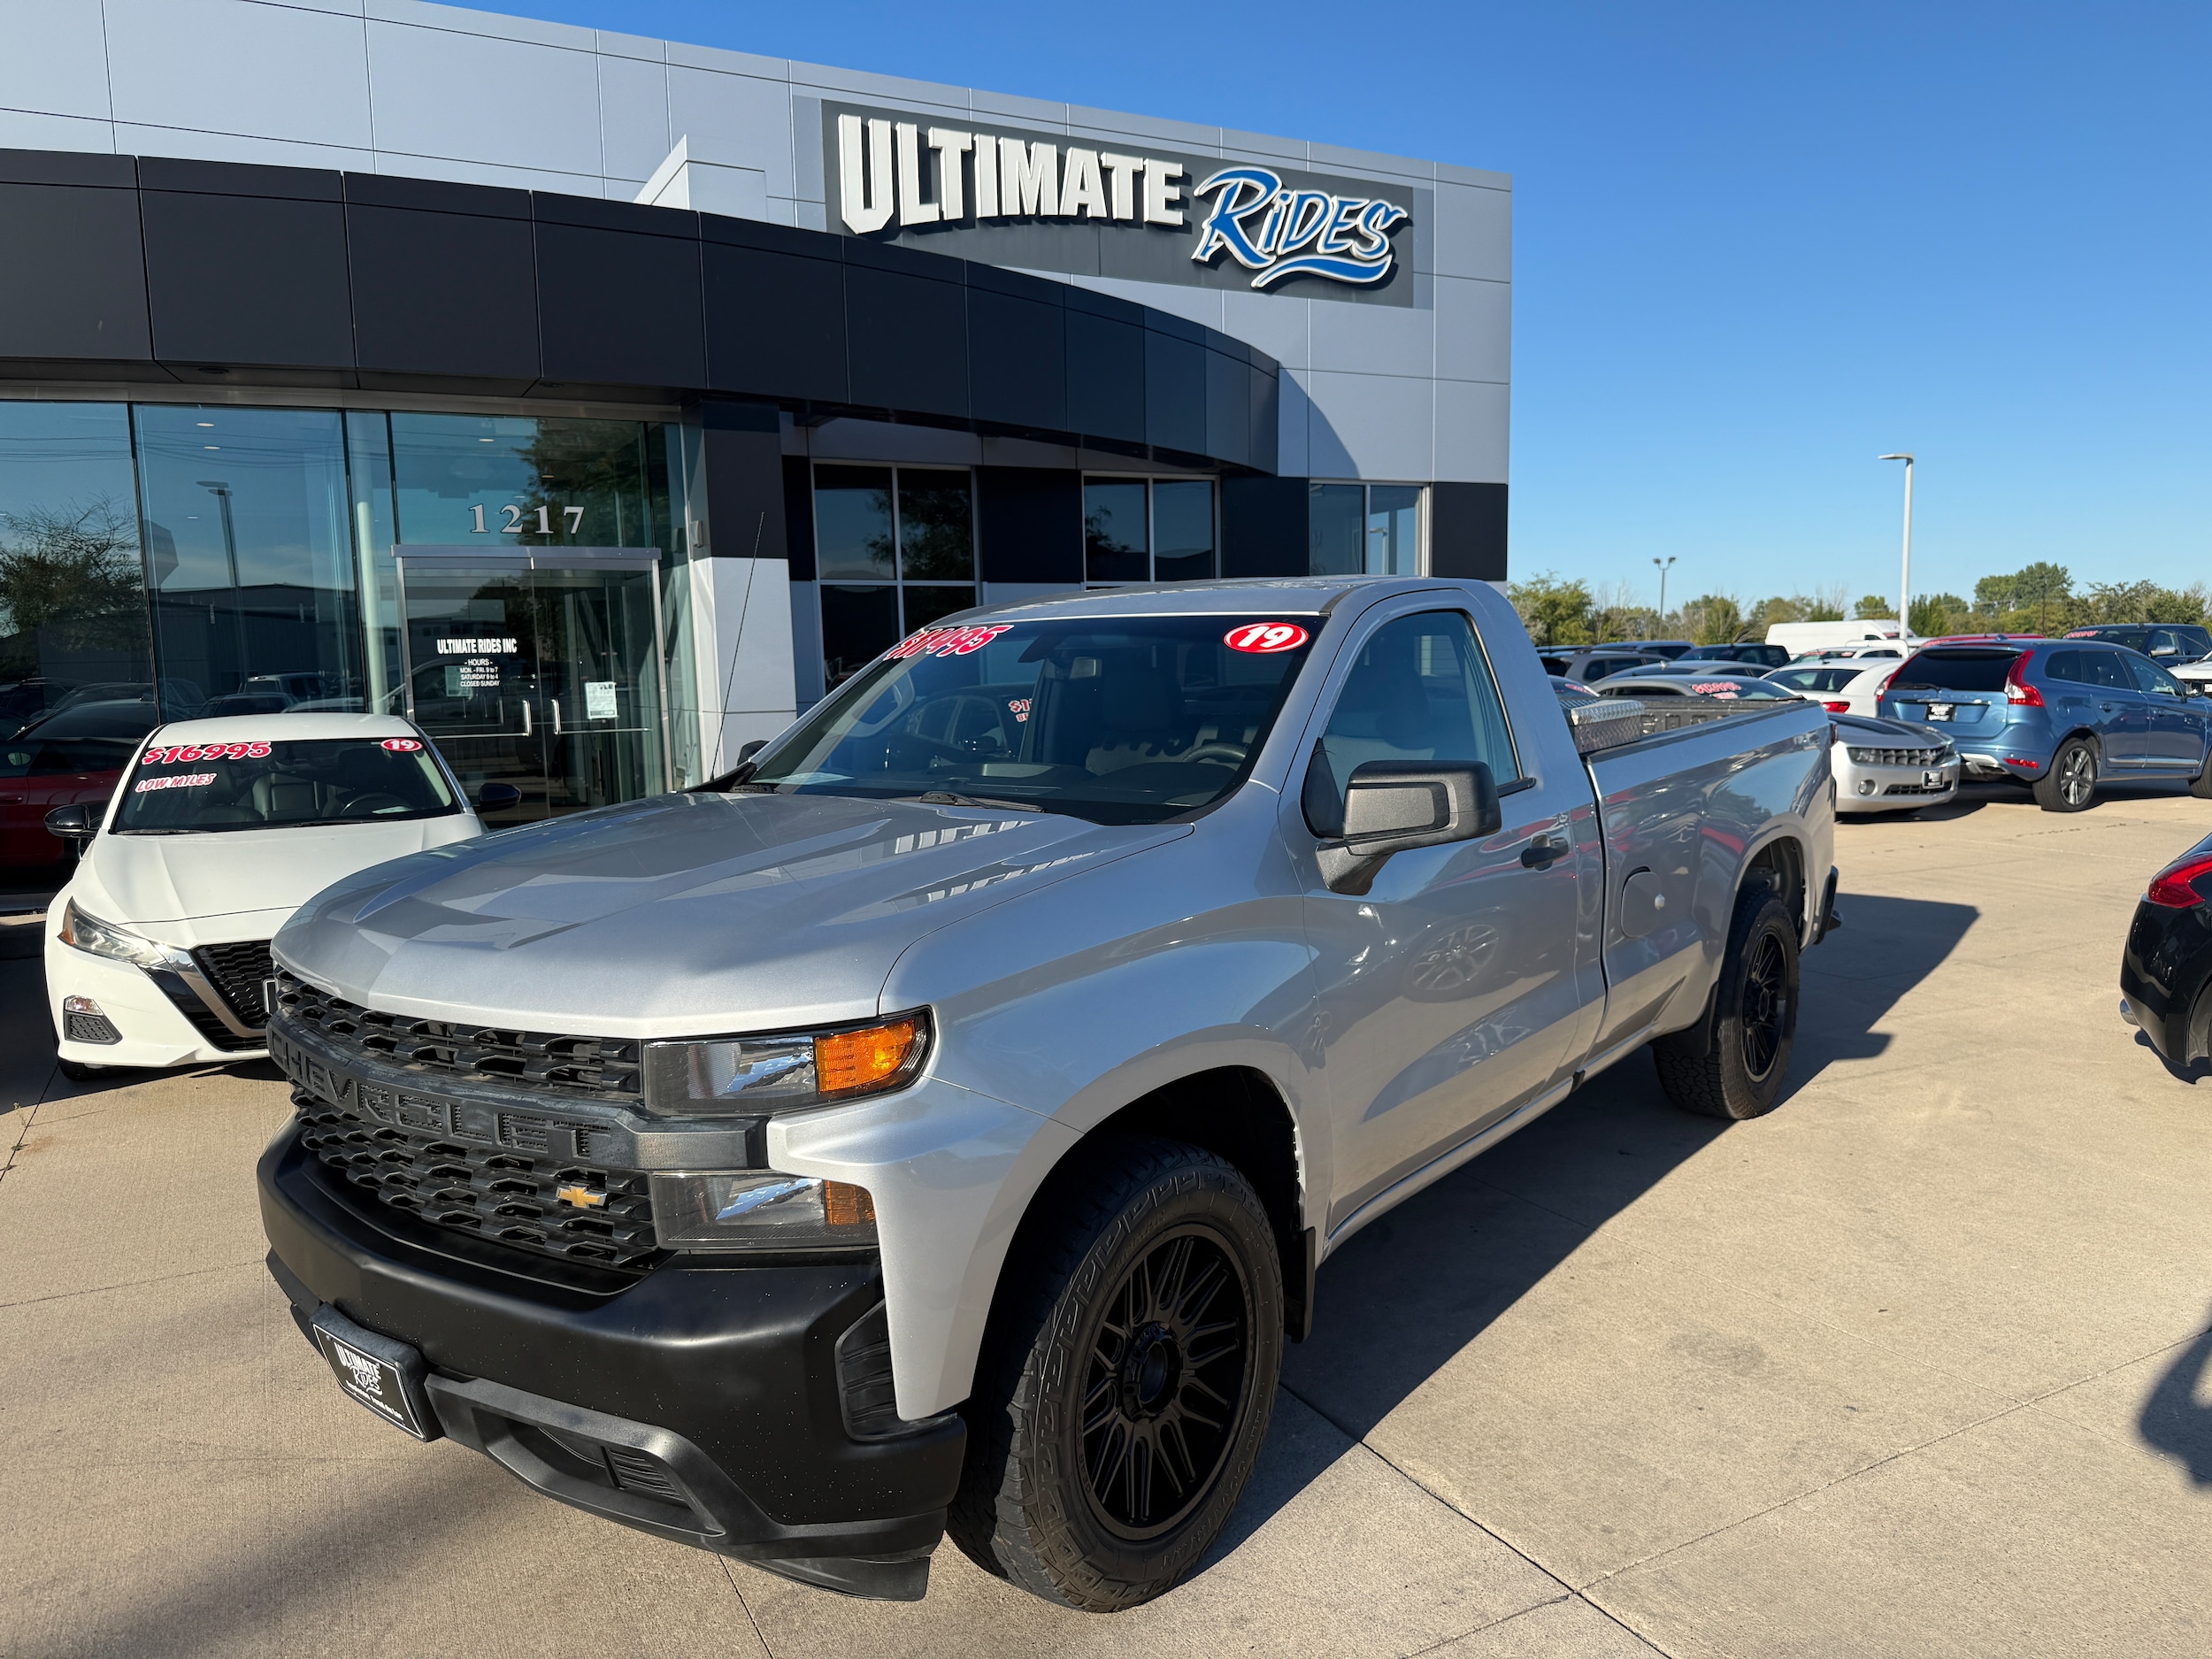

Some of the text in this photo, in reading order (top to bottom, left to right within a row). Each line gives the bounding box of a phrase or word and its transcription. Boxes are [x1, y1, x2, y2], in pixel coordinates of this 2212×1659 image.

[838, 113, 1185, 234] ULTIMATE
[469, 503, 585, 535] 1217
[437, 638, 518, 655] ULTIMATE RIDES INC
[1238, 624, 1294, 649] 19
[142, 741, 273, 765] $16995
[135, 772, 218, 794] LOW MILES
[271, 1031, 611, 1159] CHEVROLET
[334, 1341, 381, 1380] ULTIMATE
